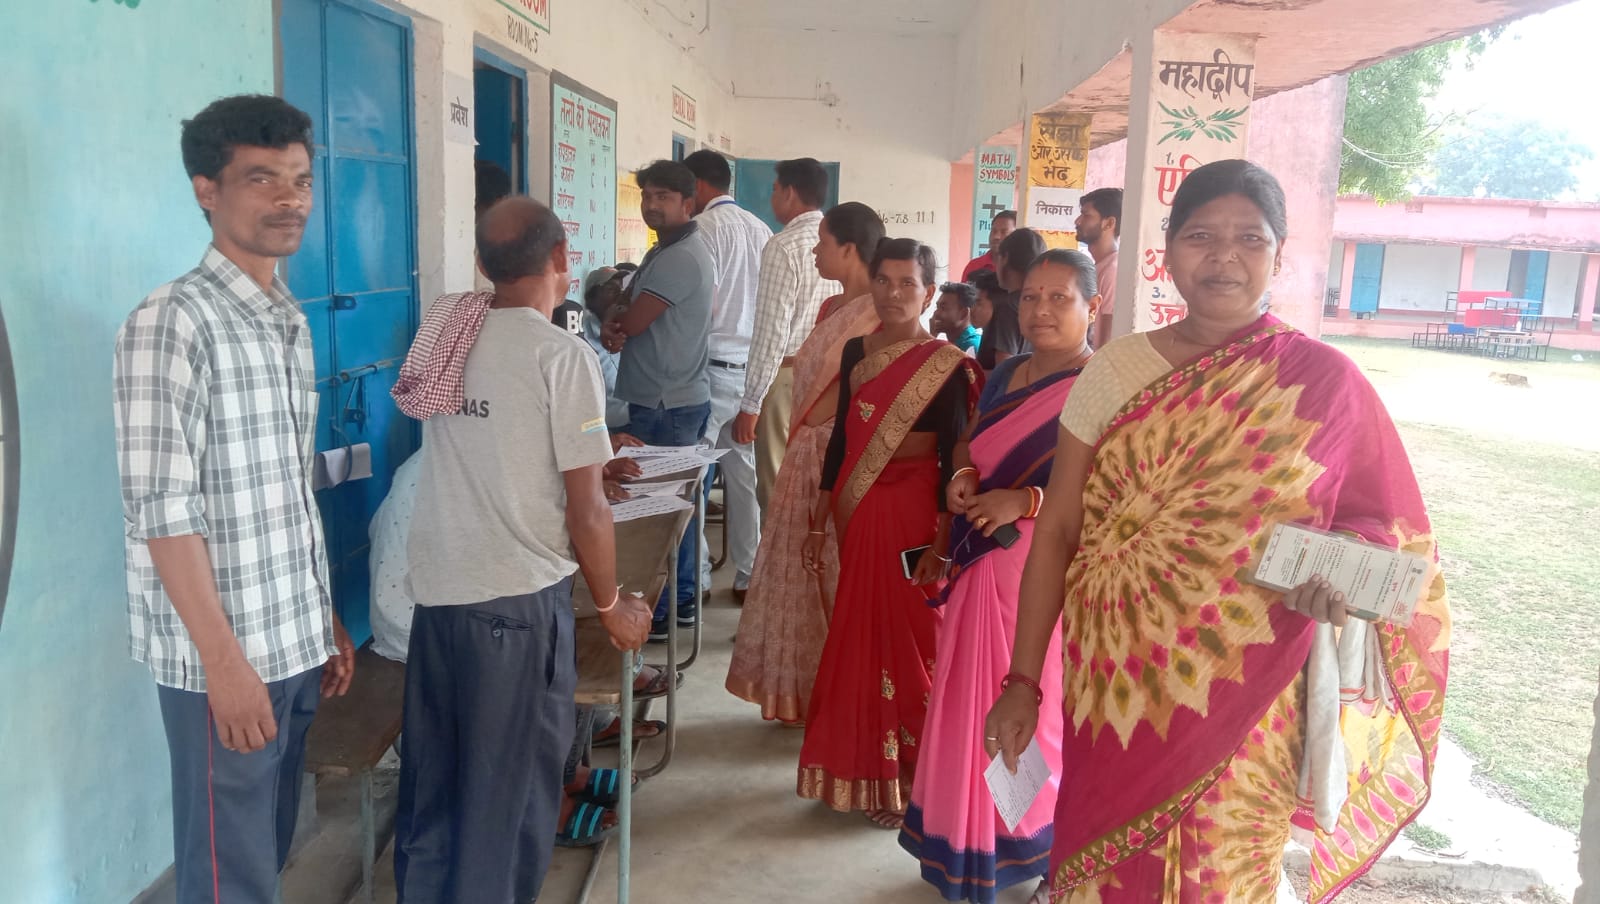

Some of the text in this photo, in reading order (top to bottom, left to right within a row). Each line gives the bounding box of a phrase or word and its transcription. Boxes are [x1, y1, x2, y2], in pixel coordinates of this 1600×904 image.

[1158, 48, 1254, 103] महाद्वीप
[450, 96, 468, 128] प्रवेश
[980, 153, 1011, 165] MATH
[979, 168, 1016, 181] SYMBOLS
[1035, 200, 1074, 216] निकास
